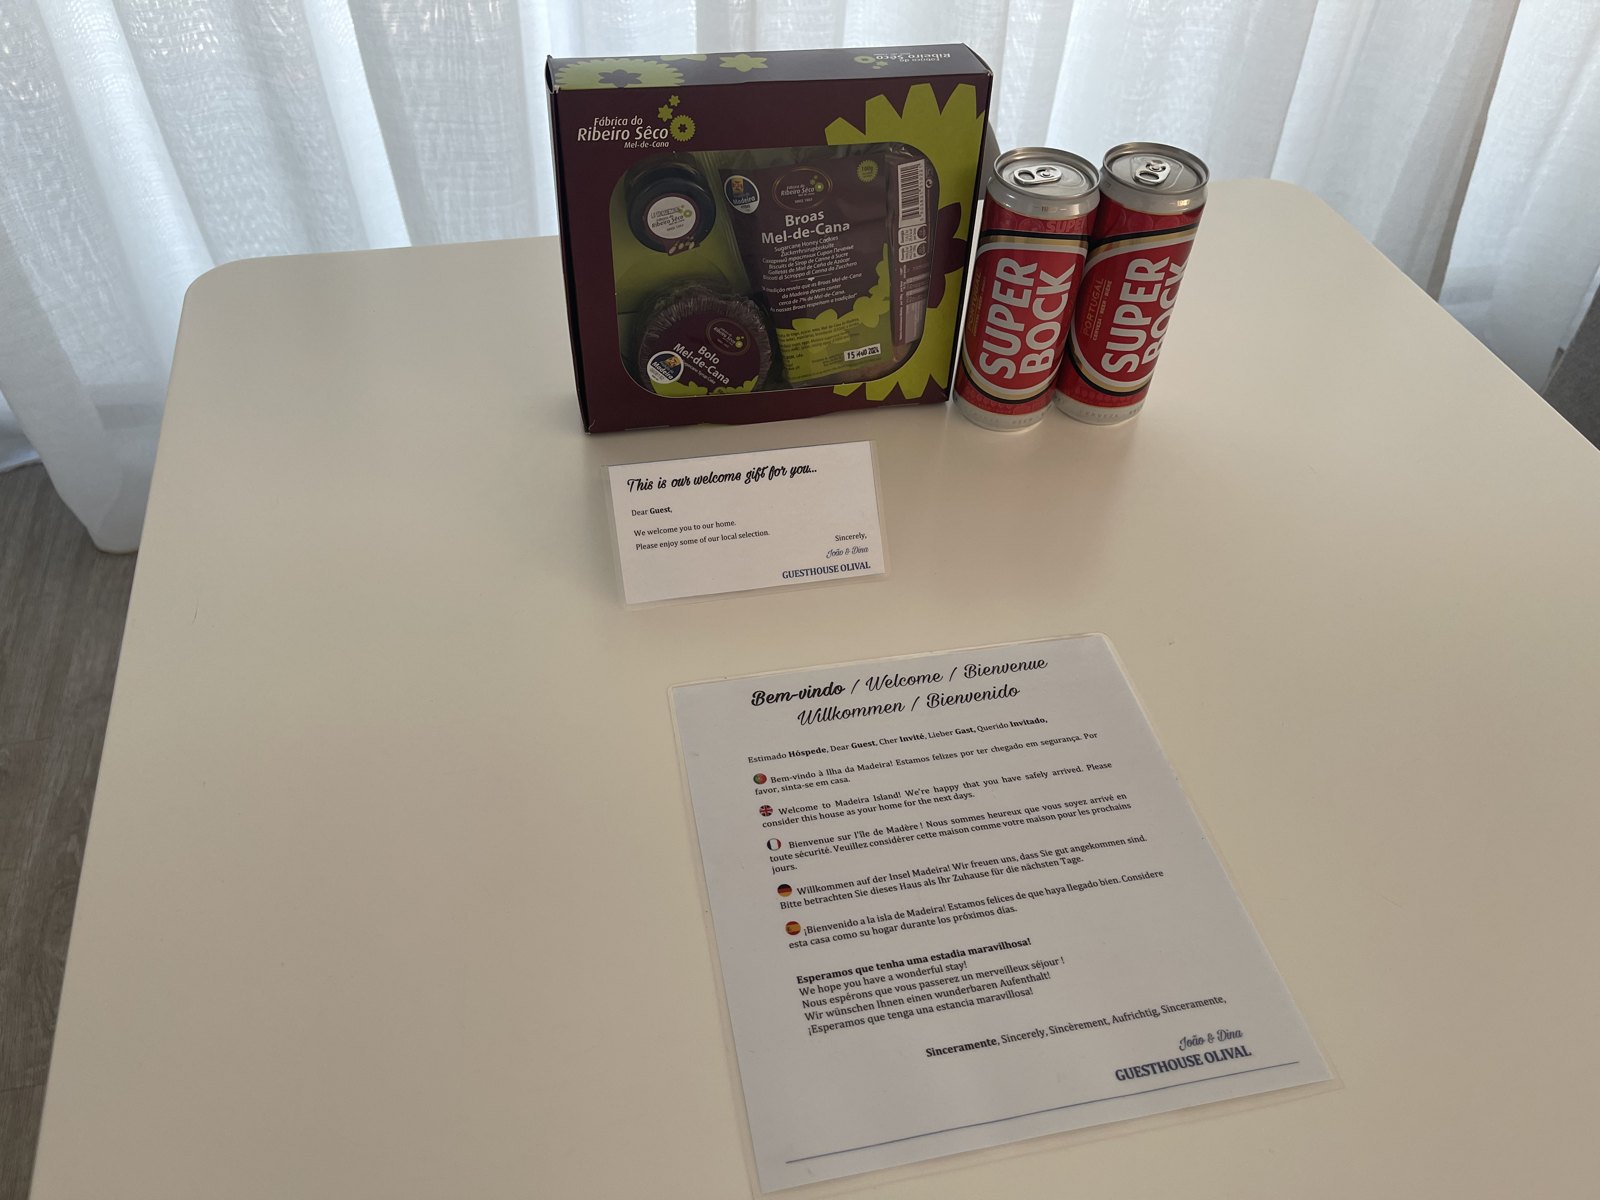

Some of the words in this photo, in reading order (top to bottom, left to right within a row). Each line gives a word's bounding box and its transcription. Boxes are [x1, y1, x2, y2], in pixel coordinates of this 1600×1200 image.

[578, 126, 630, 141] Ribeiro
[635, 126, 669, 140] Sêco
[594, 116, 628, 126] Fábrica
[631, 116, 643, 126] do
[624, 140, 669, 149] Mel-de-Cana
[762, 222, 850, 244] Mel-de-Cana
[785, 210, 825, 227] Broas
[774, 243, 801, 252] Sugarcane
[802, 240, 818, 248] Honey
[820, 236, 838, 244] Cookies
[979, 258, 1038, 379] SUPER
[1019, 263, 1076, 374] BOCK
[1083, 279, 1104, 336] PORTUGAL
[1101, 256, 1170, 372] SUPER
[673, 343, 730, 384] Mel-de-Cana
[698, 346, 720, 364] Bolo
[652, 362, 674, 380] Madeira
[626, 478, 653, 492] This
[657, 476, 666, 489] is
[670, 475, 690, 487] our
[693, 470, 741, 485] welcome
[743, 465, 769, 485] gift
[768, 464, 787, 482] for
[788, 463, 817, 479] you...
[649, 506, 672, 514] Guest,
[646, 527, 677, 535] welcome
[678, 525, 692, 533] you
[659, 540, 678, 548] enjoy
[699, 535, 706, 543] of
[720, 532, 737, 540] local
[738, 530, 768, 538] selection.
[834, 531, 867, 541] Sincerely,
[825, 548, 843, 558] João
[844, 547, 850, 555] &
[851, 545, 868, 554] Dina
[781, 564, 839, 579] GUESTHOUSE
[839, 561, 870, 571] OLIVAL
[750, 681, 845, 706] Bem-vindo
[865, 672, 943, 691] Welcome
[963, 659, 1048, 678] Bienvenue
[797, 701, 905, 725] Willkommen
[926, 684, 1020, 708] Bienvenido
[747, 752, 786, 763] Estimado
[788, 746, 828, 757] Hóspede,
[850, 740, 877, 748] Guest,
[878, 737, 897, 745] Cher
[899, 732, 927, 742] Invité,
[927, 730, 953, 738] Lieber
[976, 722, 1008, 732] Querido
[1009, 717, 1047, 727] Invitado,
[770, 771, 816, 783] Bem-vindo
[844, 765, 855, 773] da
[856, 760, 893, 771] Madeira!
[895, 756, 930, 765] Estamos
[931, 752, 958, 760] felizes
[959, 750, 974, 758] por
[990, 742, 1023, 752] chegado
[1040, 735, 1082, 746] segurança.
[777, 804, 818, 815] Welcome
[834, 797, 869, 807] Madeira
[872, 791, 901, 801] Island!
[904, 788, 929, 796] We're
[932, 784, 958, 793] happy
[962, 780, 980, 788] that
[982, 778, 998, 787] you
[1000, 775, 1021, 783] have
[1024, 770, 1047, 779] safely
[1051, 765, 1083, 775] arrived.
[1085, 762, 1112, 770] Please
[761, 816, 799, 828] consider
[800, 814, 817, 822] this
[818, 810, 844, 819] house
[856, 806, 877, 815] your
[877, 802, 902, 810] home
[903, 799, 916, 807] for
[917, 797, 931, 805] the
[932, 794, 952, 802] next
[952, 792, 974, 800] days.
[796, 968, 853, 984] Esperamos
[854, 965, 873, 975] que
[875, 959, 905, 970] tenha
[906, 956, 928, 965] uma
[930, 949, 966, 961] estadia
[967, 937, 1031, 955] maravilhosa!
[798, 986, 815, 996] We
[816, 983, 841, 993] hope
[842, 979, 861, 991] you
[862, 975, 886, 985] have
[894, 963, 943, 979] wonderful
[944, 960, 967, 971] stay!
[925, 1038, 1000, 1057] Sinceramente,
[1000, 1028, 1048, 1043] Sincerely,
[1048, 1017, 1110, 1034] Sincèrement,
[1112, 1008, 1160, 1023] Aufrichtig,
[1160, 996, 1226, 1013] Sinceramente,
[1178, 1034, 1205, 1051] João
[1216, 1028, 1243, 1041] Dina
[1114, 1053, 1203, 1081] GUESTHOUSE
[1203, 1045, 1252, 1063] OLIVAL
